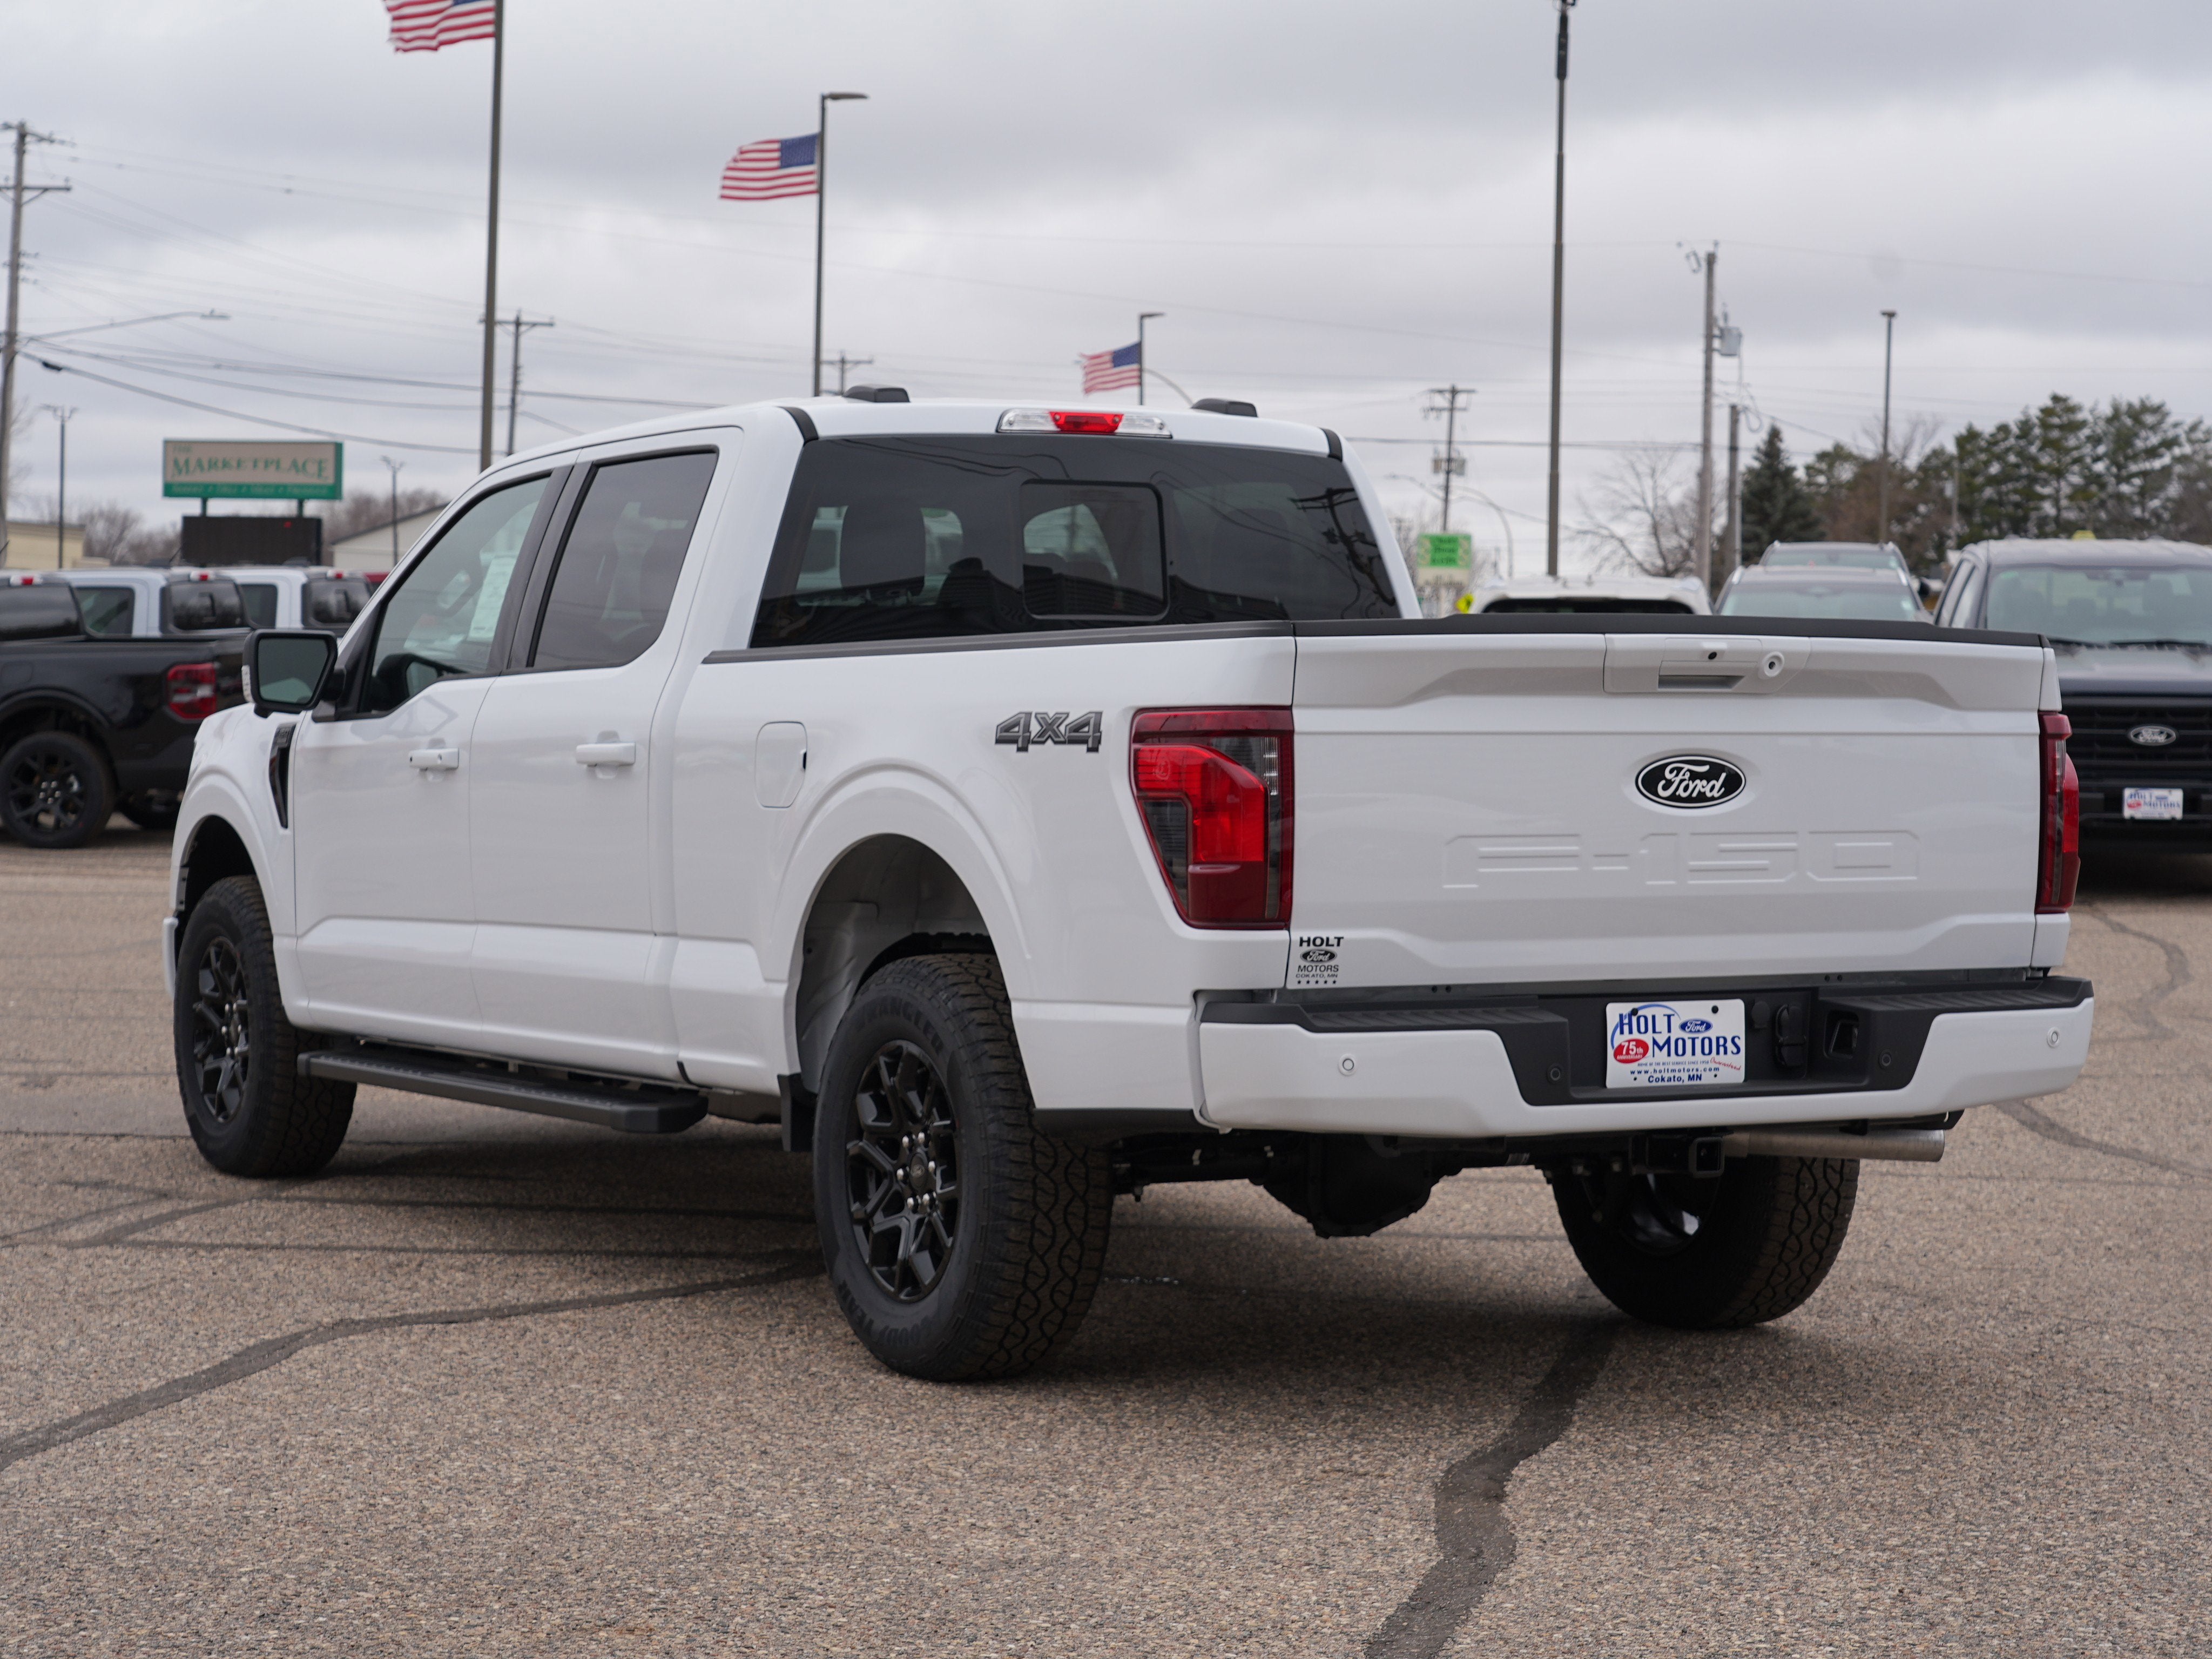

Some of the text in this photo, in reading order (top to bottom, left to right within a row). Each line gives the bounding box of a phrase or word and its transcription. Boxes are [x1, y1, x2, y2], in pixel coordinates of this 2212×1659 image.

[171, 457, 329, 480] MARKETPLACE
[1657, 763, 1727, 798] Ford
[1443, 830, 1920, 888] F-150
[1299, 936, 1344, 947] HOLT
[1619, 1013, 1675, 1035] HOLT
[1621, 1041, 1644, 1055] 75th
[1653, 1036, 1741, 1057] MOTORS
[1648, 1075, 1684, 1083] Cokato,
